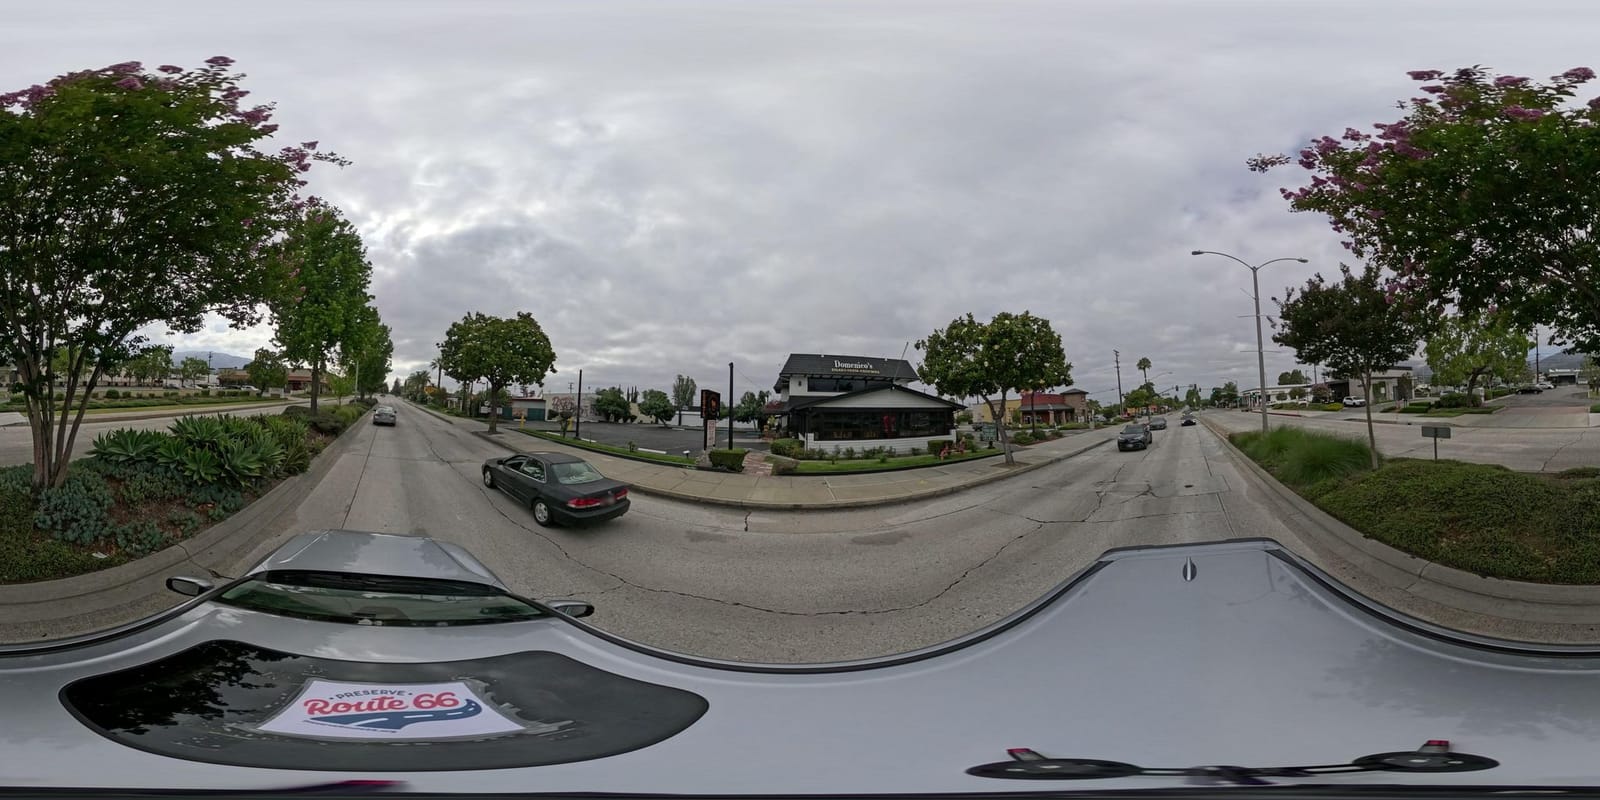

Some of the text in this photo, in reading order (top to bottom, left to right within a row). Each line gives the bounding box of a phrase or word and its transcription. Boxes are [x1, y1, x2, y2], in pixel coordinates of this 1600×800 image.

[834, 360, 873, 369] Domenico's
[335, 690, 406, 699] PRESERVE
[304, 692, 460, 715] Route 66
